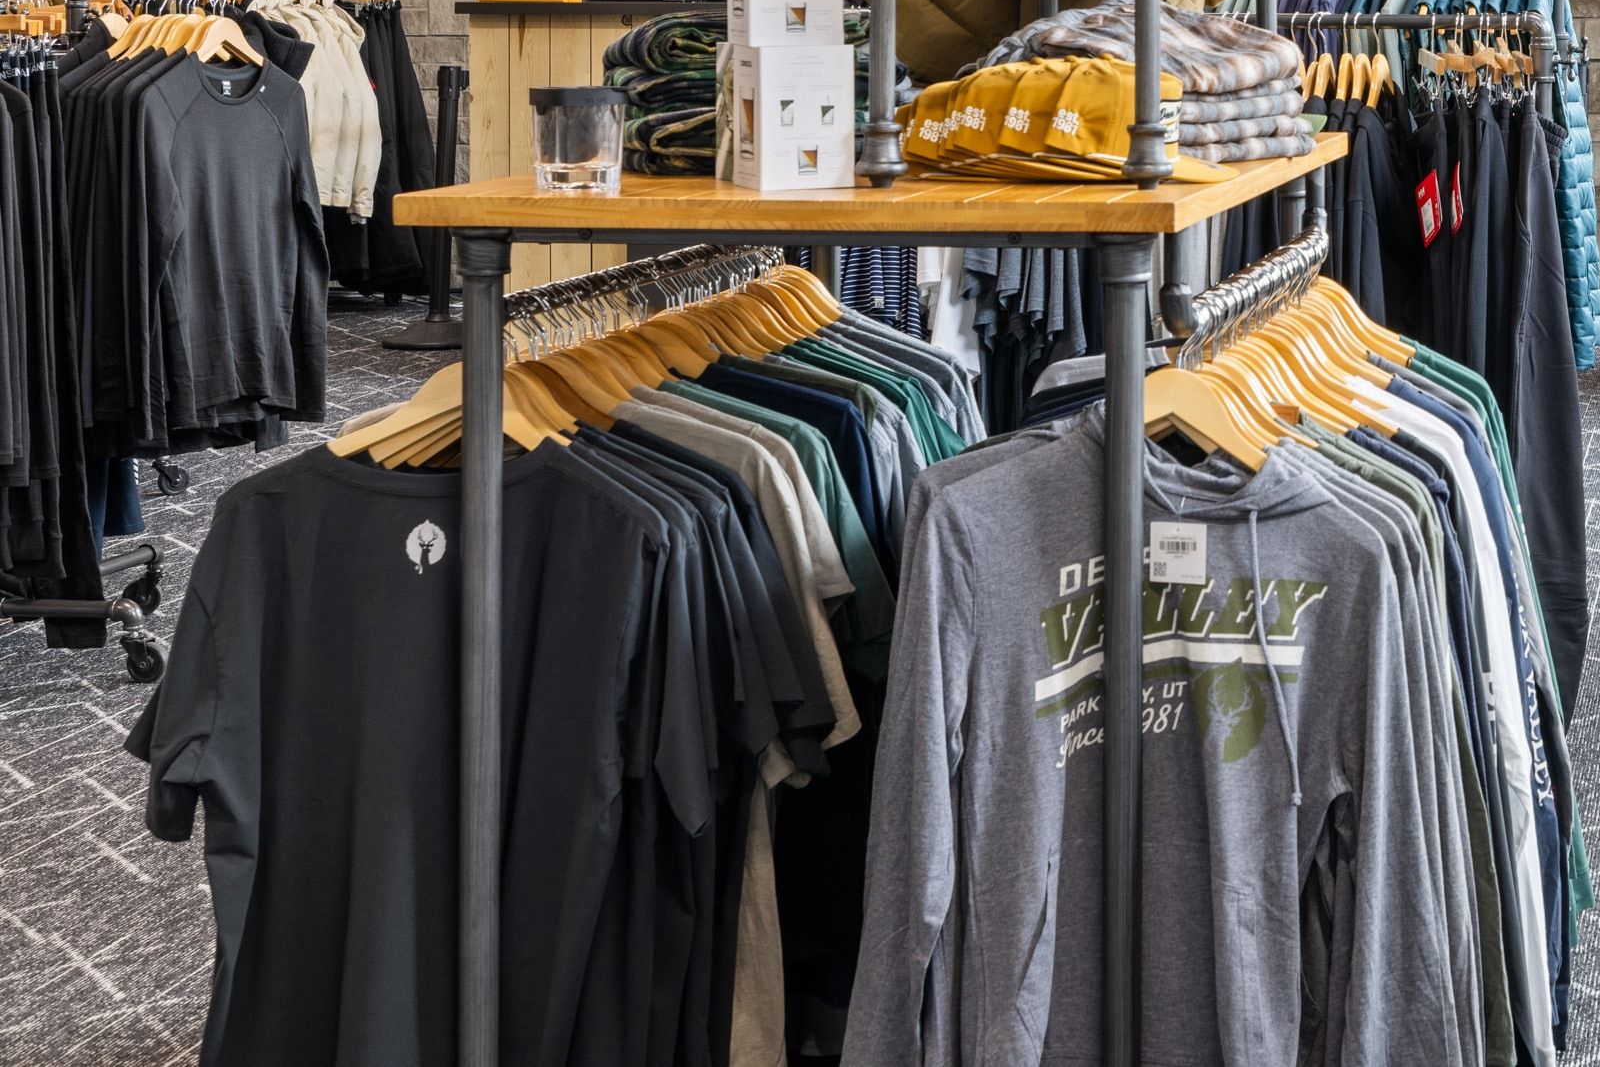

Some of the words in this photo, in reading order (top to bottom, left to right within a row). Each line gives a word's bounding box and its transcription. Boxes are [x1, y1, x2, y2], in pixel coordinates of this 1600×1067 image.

[960, 114, 986, 132] 1981
[1004, 114, 1029, 133] 1981
[1052, 117, 1079, 136] 1981
[1060, 695, 1101, 734] PARK
[1162, 681, 1188, 696] UT
[1056, 726, 1104, 769] Since
[1142, 702, 1184, 734] 981
